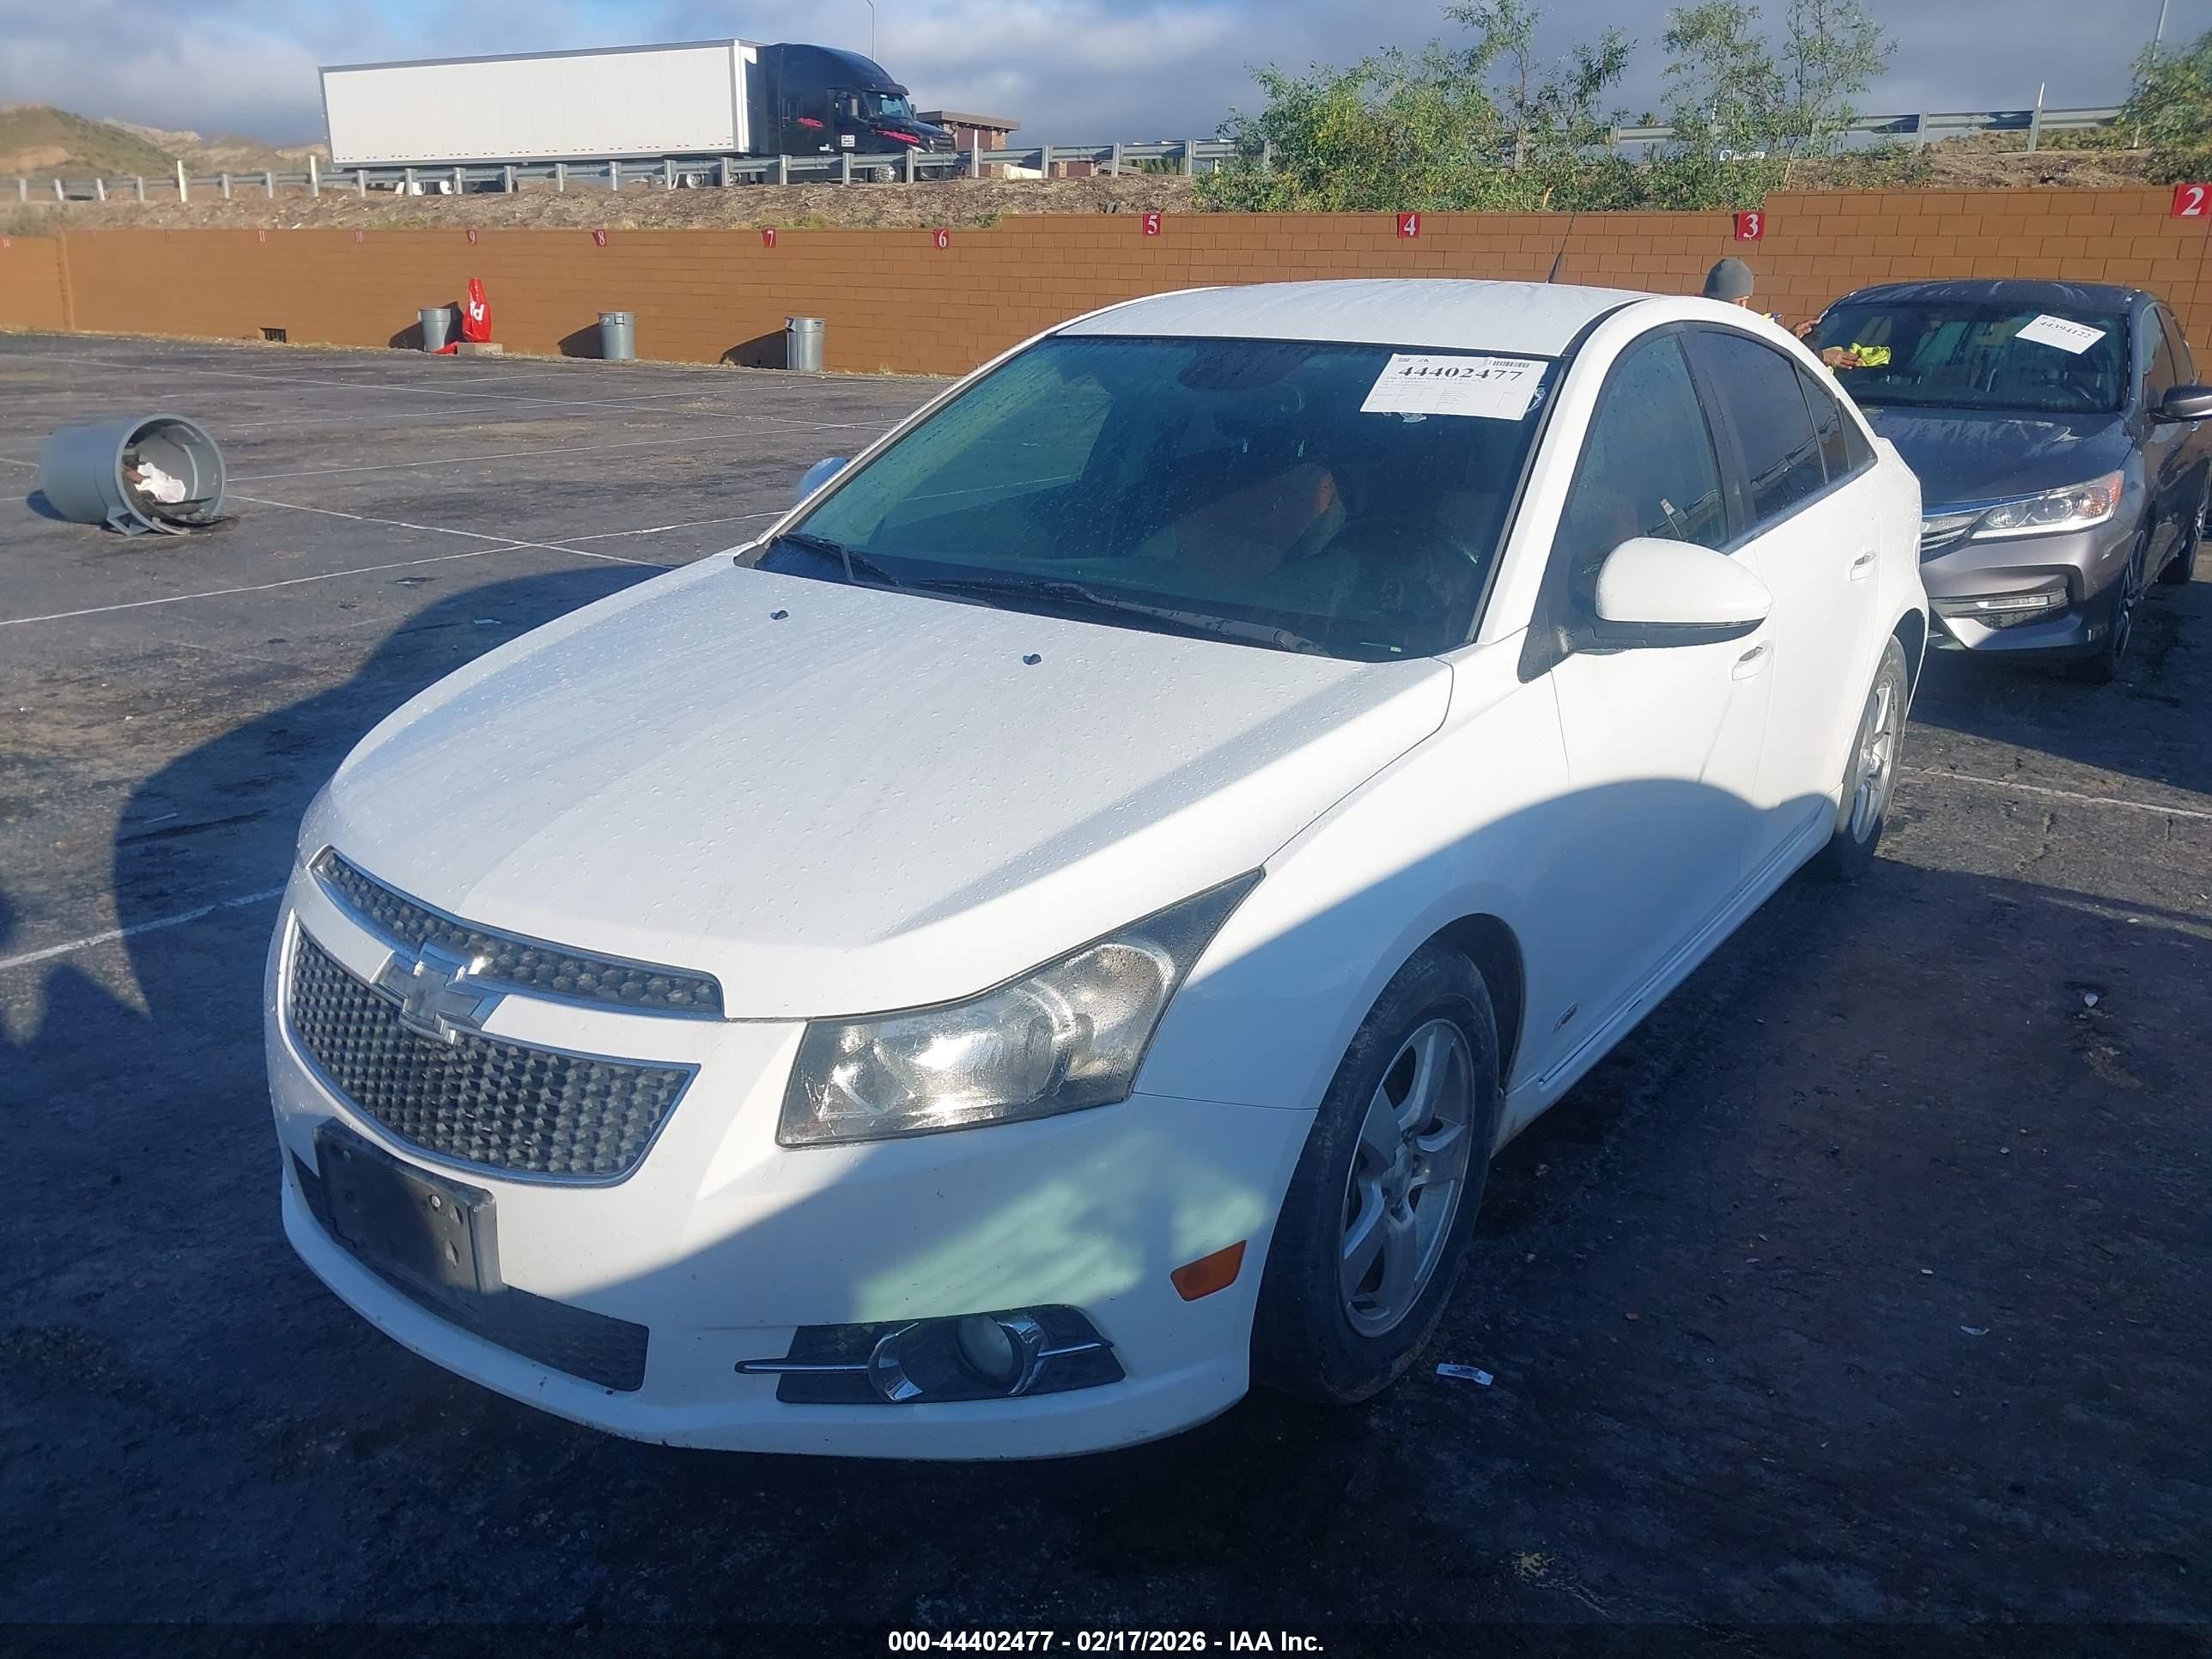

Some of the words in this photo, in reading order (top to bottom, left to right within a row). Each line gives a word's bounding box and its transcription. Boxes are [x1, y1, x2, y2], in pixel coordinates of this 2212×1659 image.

[2181, 186, 2204, 216] 2
[1147, 215, 1158, 234] 5
[1404, 214, 1416, 236] 4
[1743, 214, 1759, 238] 3
[469, 230, 476, 245] 9
[598, 230, 605, 246] 8
[767, 230, 774, 246] 7
[939, 230, 947, 247] 6
[1398, 366, 1524, 382] 44402477
